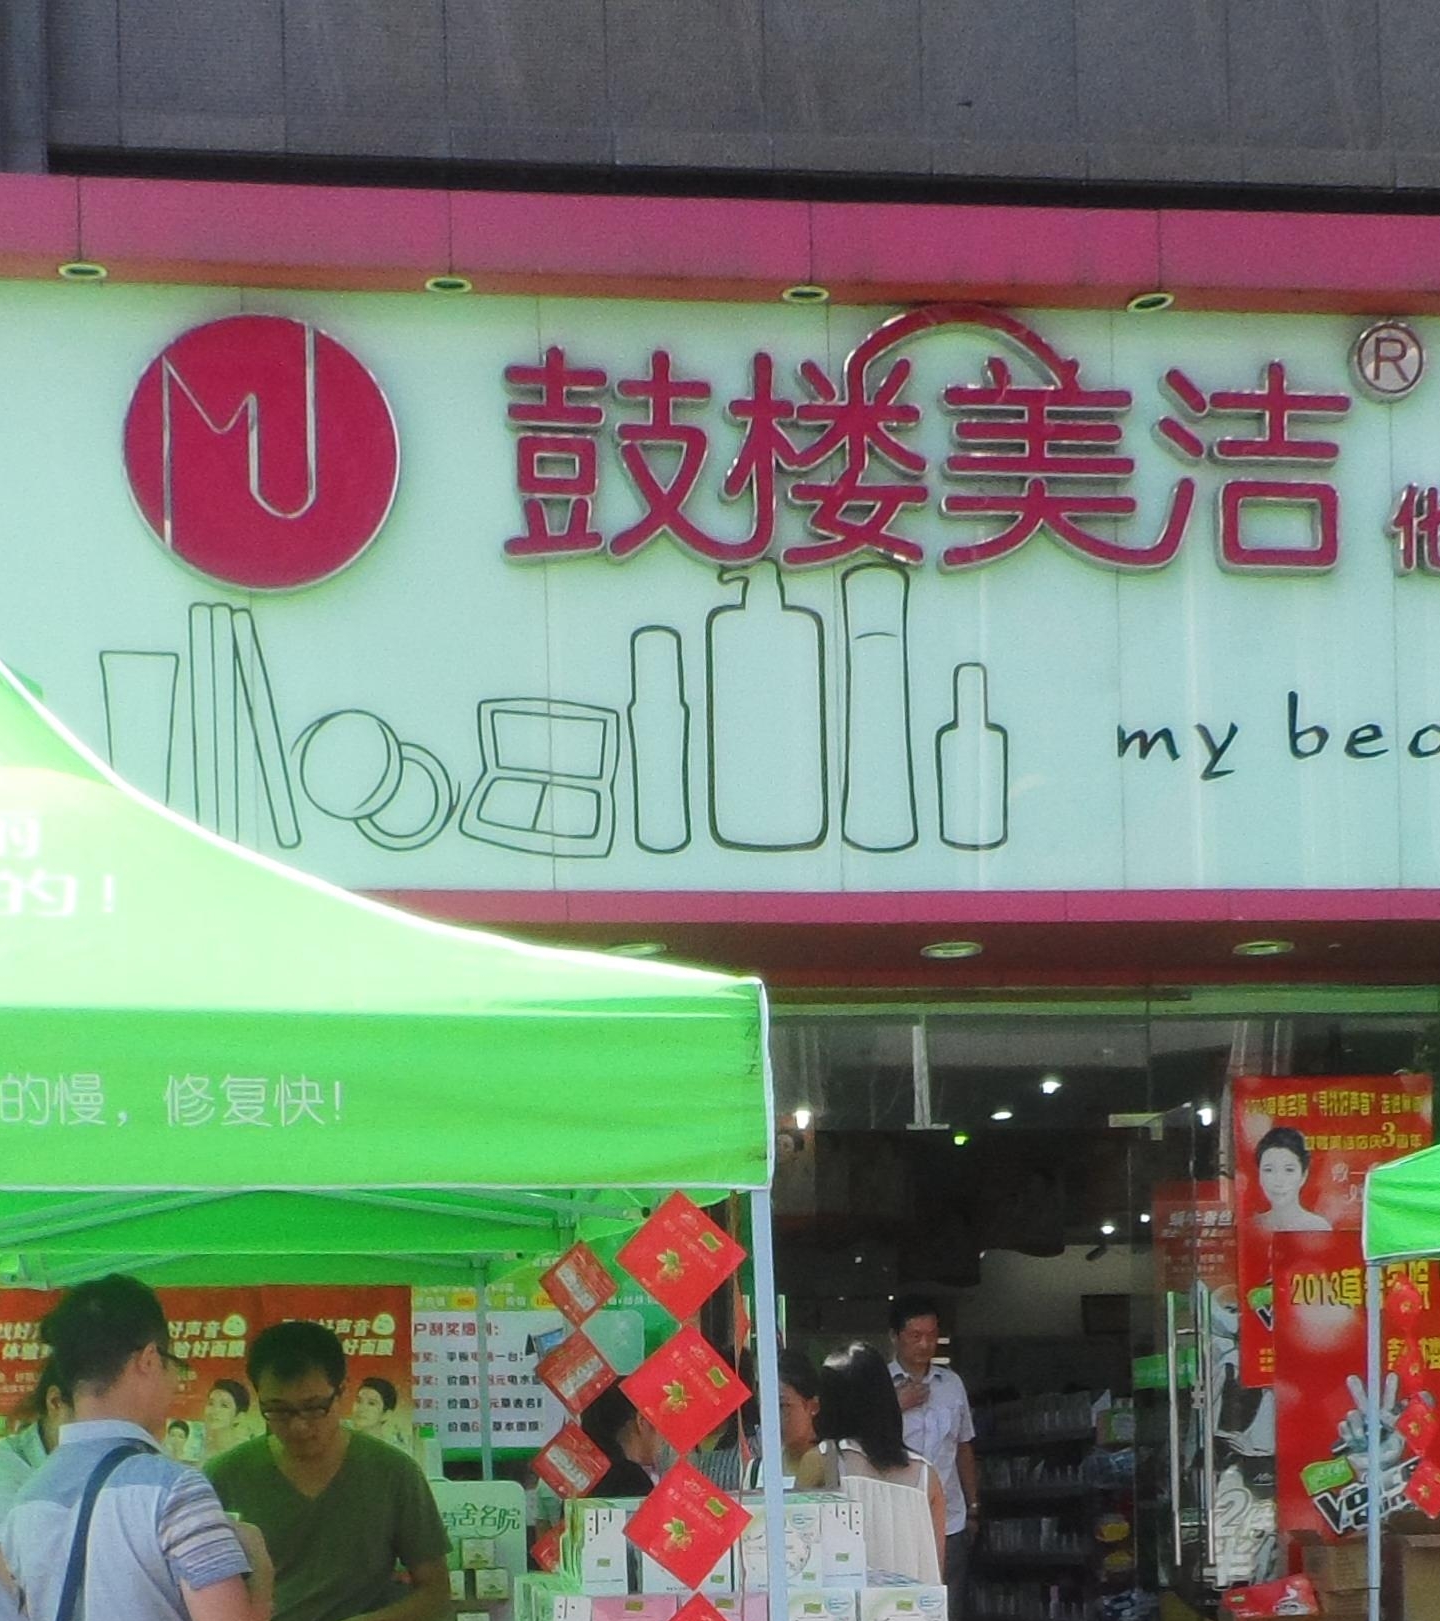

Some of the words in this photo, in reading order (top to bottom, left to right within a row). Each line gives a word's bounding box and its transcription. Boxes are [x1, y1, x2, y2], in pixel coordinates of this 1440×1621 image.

[502, 344, 1353, 571] 鼓楼美洁
[1116, 719, 1241, 779] my
